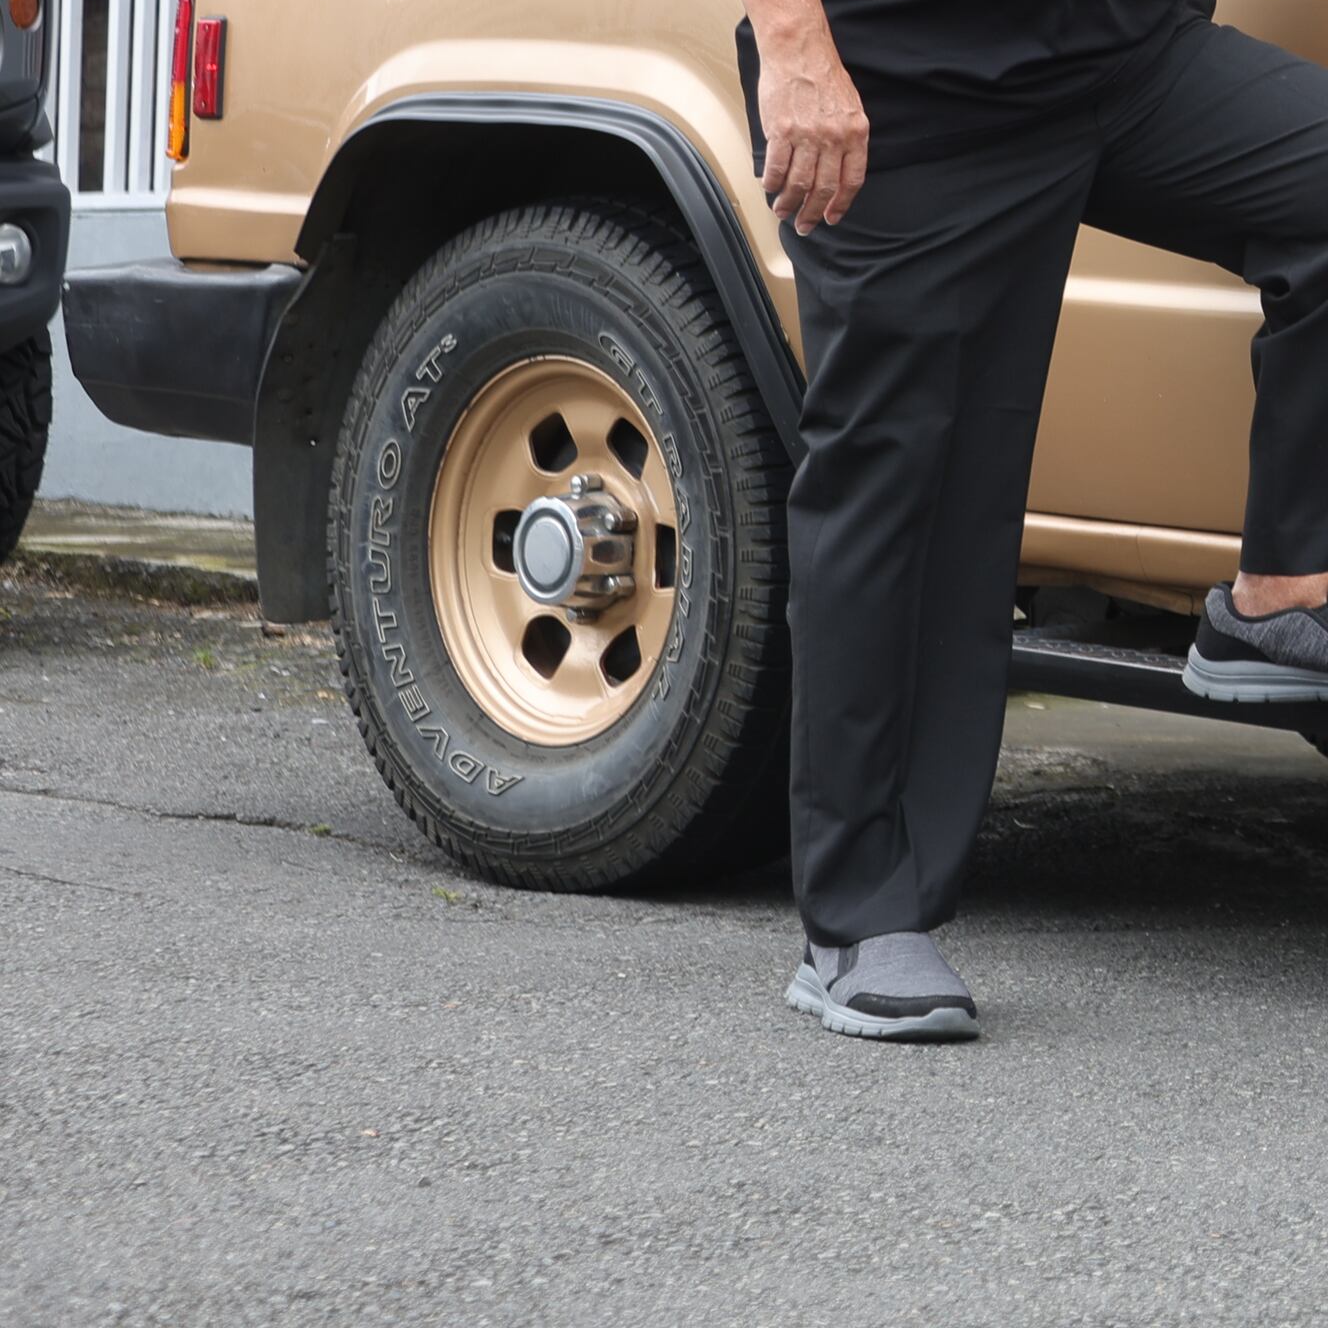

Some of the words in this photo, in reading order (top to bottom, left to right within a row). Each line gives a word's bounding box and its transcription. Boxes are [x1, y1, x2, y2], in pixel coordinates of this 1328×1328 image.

[369, 439, 526, 797] ADVENTURO
[598, 331, 665, 418] GT
[651, 433, 697, 703] RADIAL
